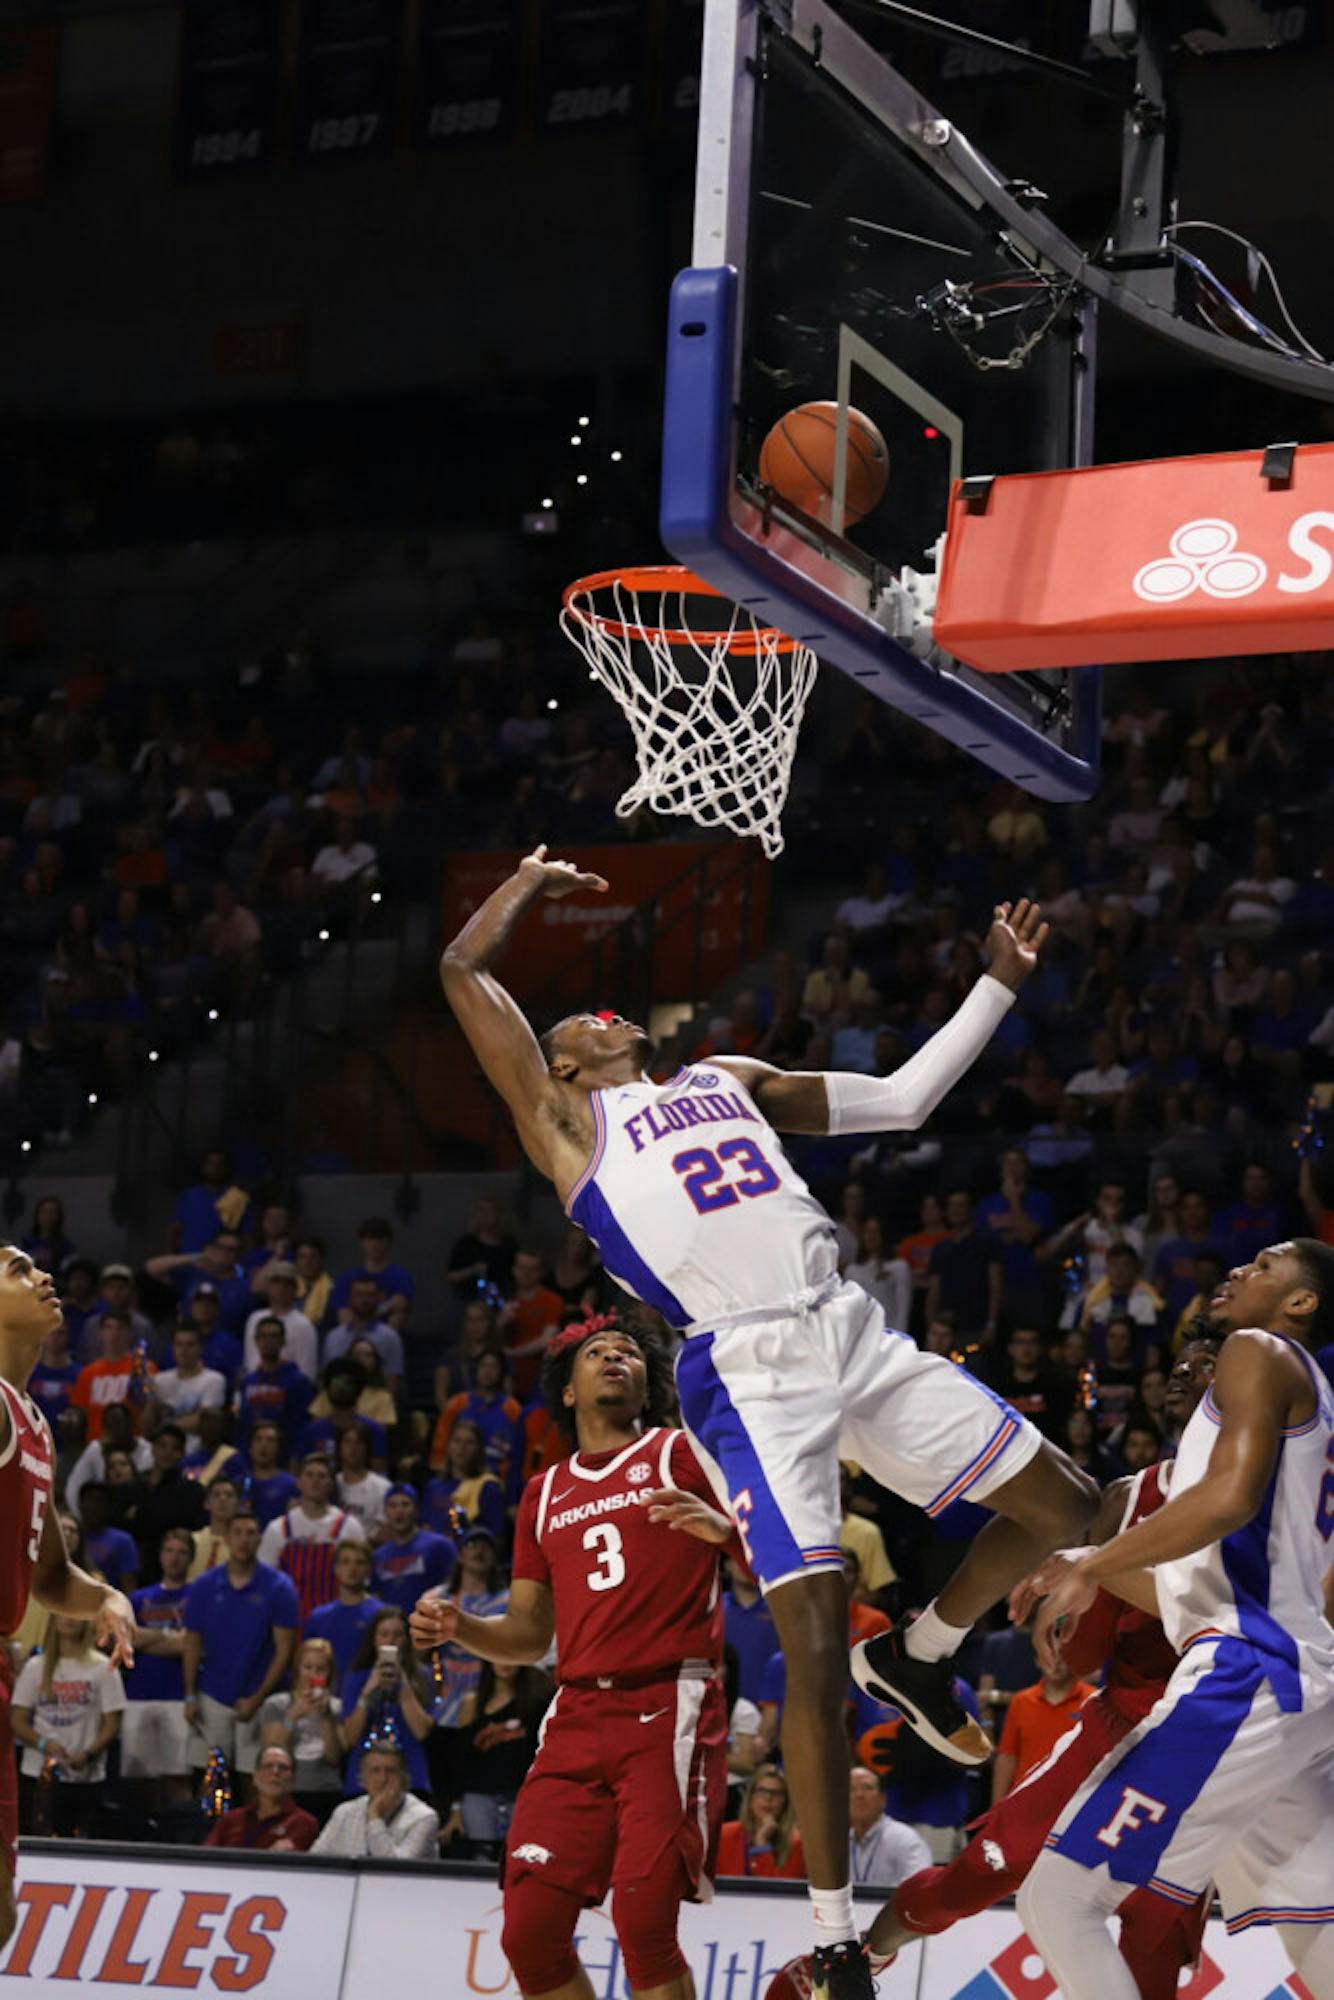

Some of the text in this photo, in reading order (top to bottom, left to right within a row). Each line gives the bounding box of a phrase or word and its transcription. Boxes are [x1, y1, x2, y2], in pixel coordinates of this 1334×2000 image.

[309, 113, 380, 153] 1997
[546, 82, 632, 123] 2004
[191, 128, 262, 168] 1994
[624, 1092, 761, 1154] FLORIDA
[672, 1136, 782, 1215] 23
[27, 1488, 47, 1562] 5
[583, 1522, 626, 1592] 3
[1096, 1786, 1168, 1849] F
[0, 1881, 288, 1992] TILES
